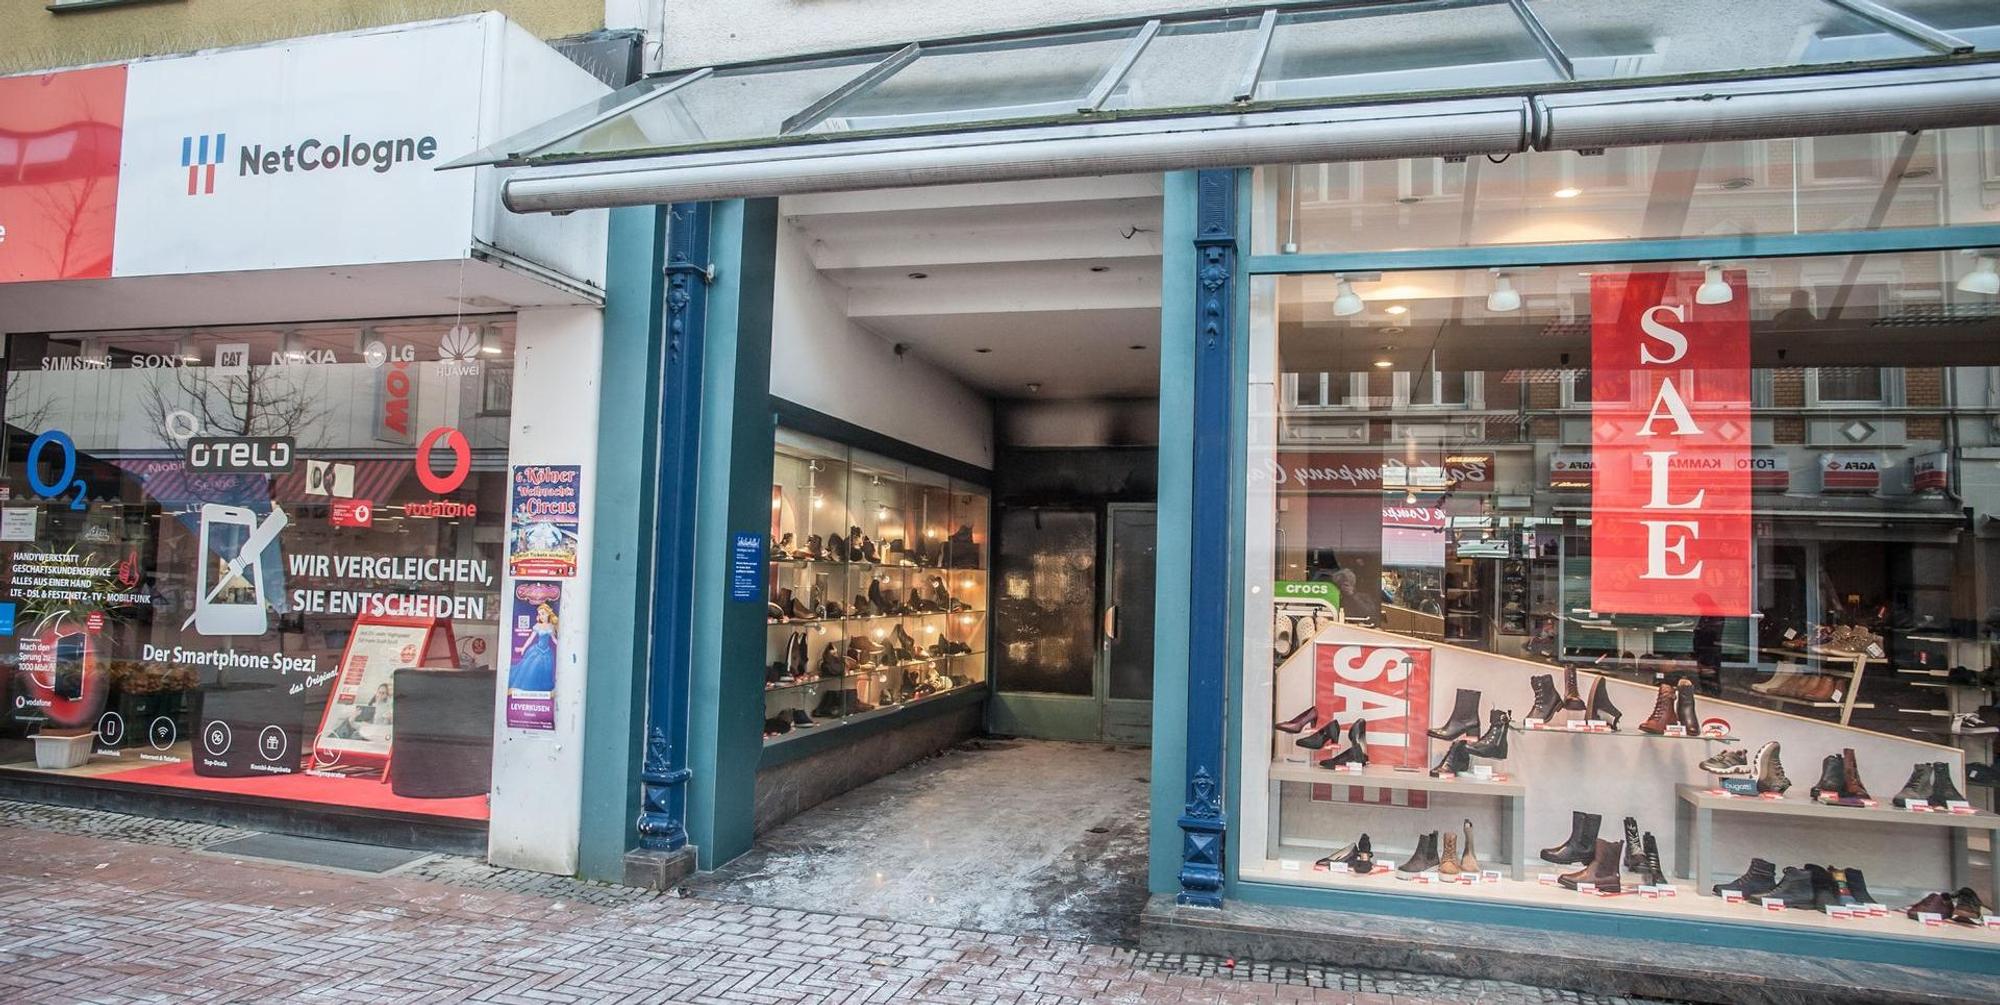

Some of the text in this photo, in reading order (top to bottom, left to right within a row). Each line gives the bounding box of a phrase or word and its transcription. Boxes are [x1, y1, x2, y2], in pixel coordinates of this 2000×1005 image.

[239, 134, 437, 176] NetCologne
[131, 354, 188, 368] SONY
[222, 351, 242, 366] CAT
[271, 349, 337, 366] NOKIA
[391, 345, 415, 362] LG
[41, 355, 113, 371] SAMSUNG
[437, 366, 480, 376] HUAWEI
[1635, 304, 1705, 580] SALE
[524, 467, 575, 485] Kölner
[404, 500, 477, 517] vodafone
[526, 498, 576, 515] Circus
[13, 552, 79, 563] HANDYWERKSTATT
[289, 555, 493, 586] WIR VERGLEICHEN,
[11, 577, 91, 589] ALLES AUS EINER HAND
[1286, 584, 1328, 594] crocs
[10, 588, 23, 597] LTE
[27, 589, 40, 598] DSL
[92, 592, 102, 600] TV
[107, 593, 151, 603] MOBILFUNK
[293, 590, 484, 620] SIE ENTSCHEIDEN
[20, 642, 50, 651] Mach den
[19, 652, 42, 662] Sprung
[143, 644, 316, 675] Der Smartphone Spezi
[19, 663, 34, 671] 1000
[289, 683, 304, 695] das
[306, 665, 338, 687] Original
[26, 699, 52, 707] vodafone
[511, 703, 550, 712] LEVERKUSEN
[204, 759, 228, 768] Top-Deals
